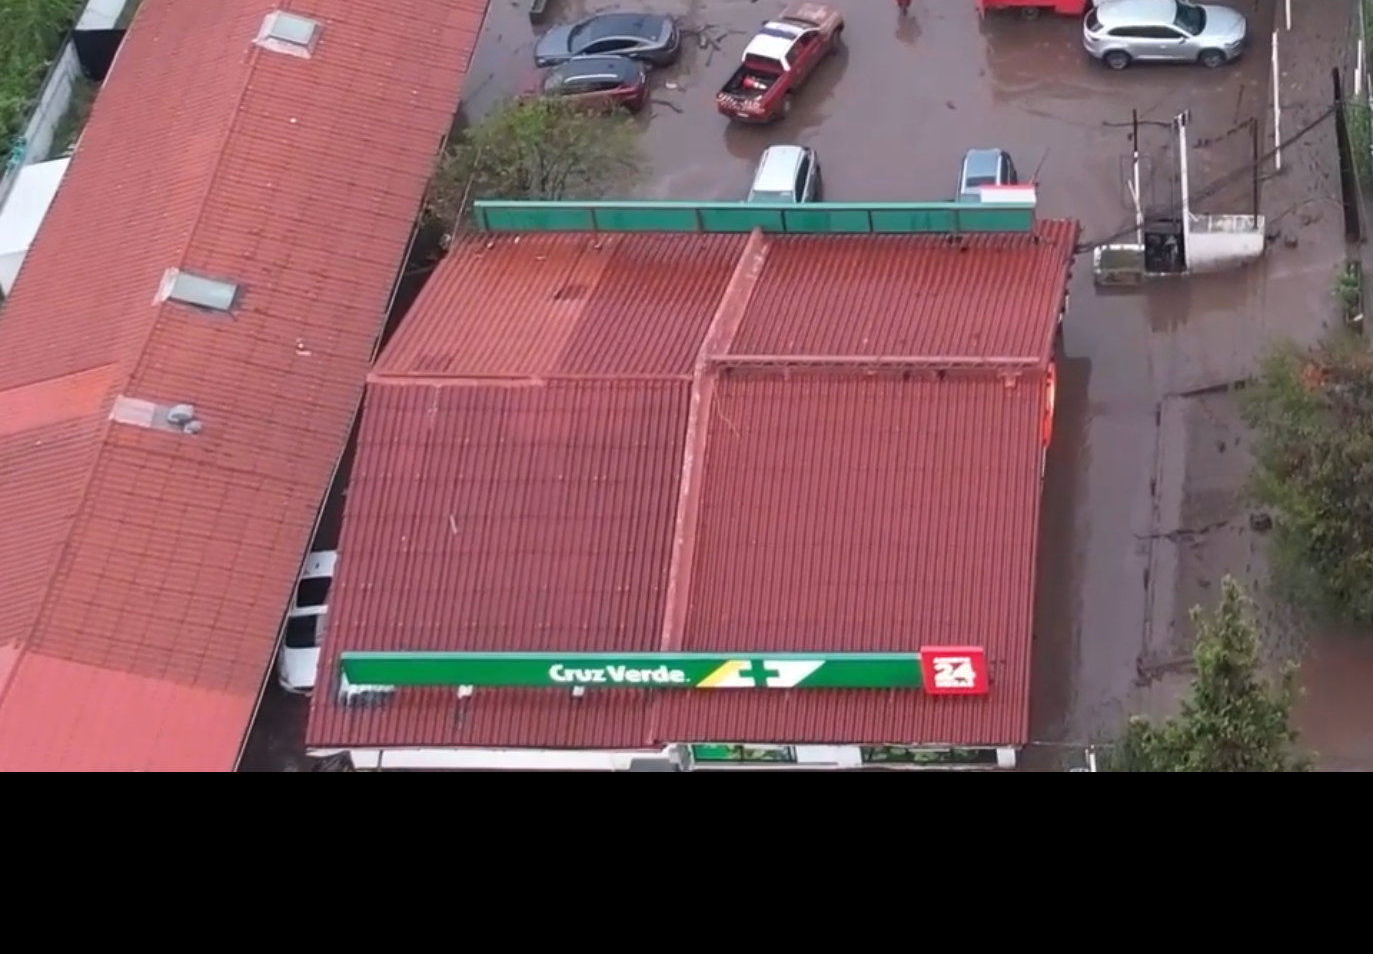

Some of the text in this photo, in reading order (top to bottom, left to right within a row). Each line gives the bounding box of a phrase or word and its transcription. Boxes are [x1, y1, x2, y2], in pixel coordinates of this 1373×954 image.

[549, 664, 685, 683] Cruz Verde
[934, 662, 976, 681] 24
